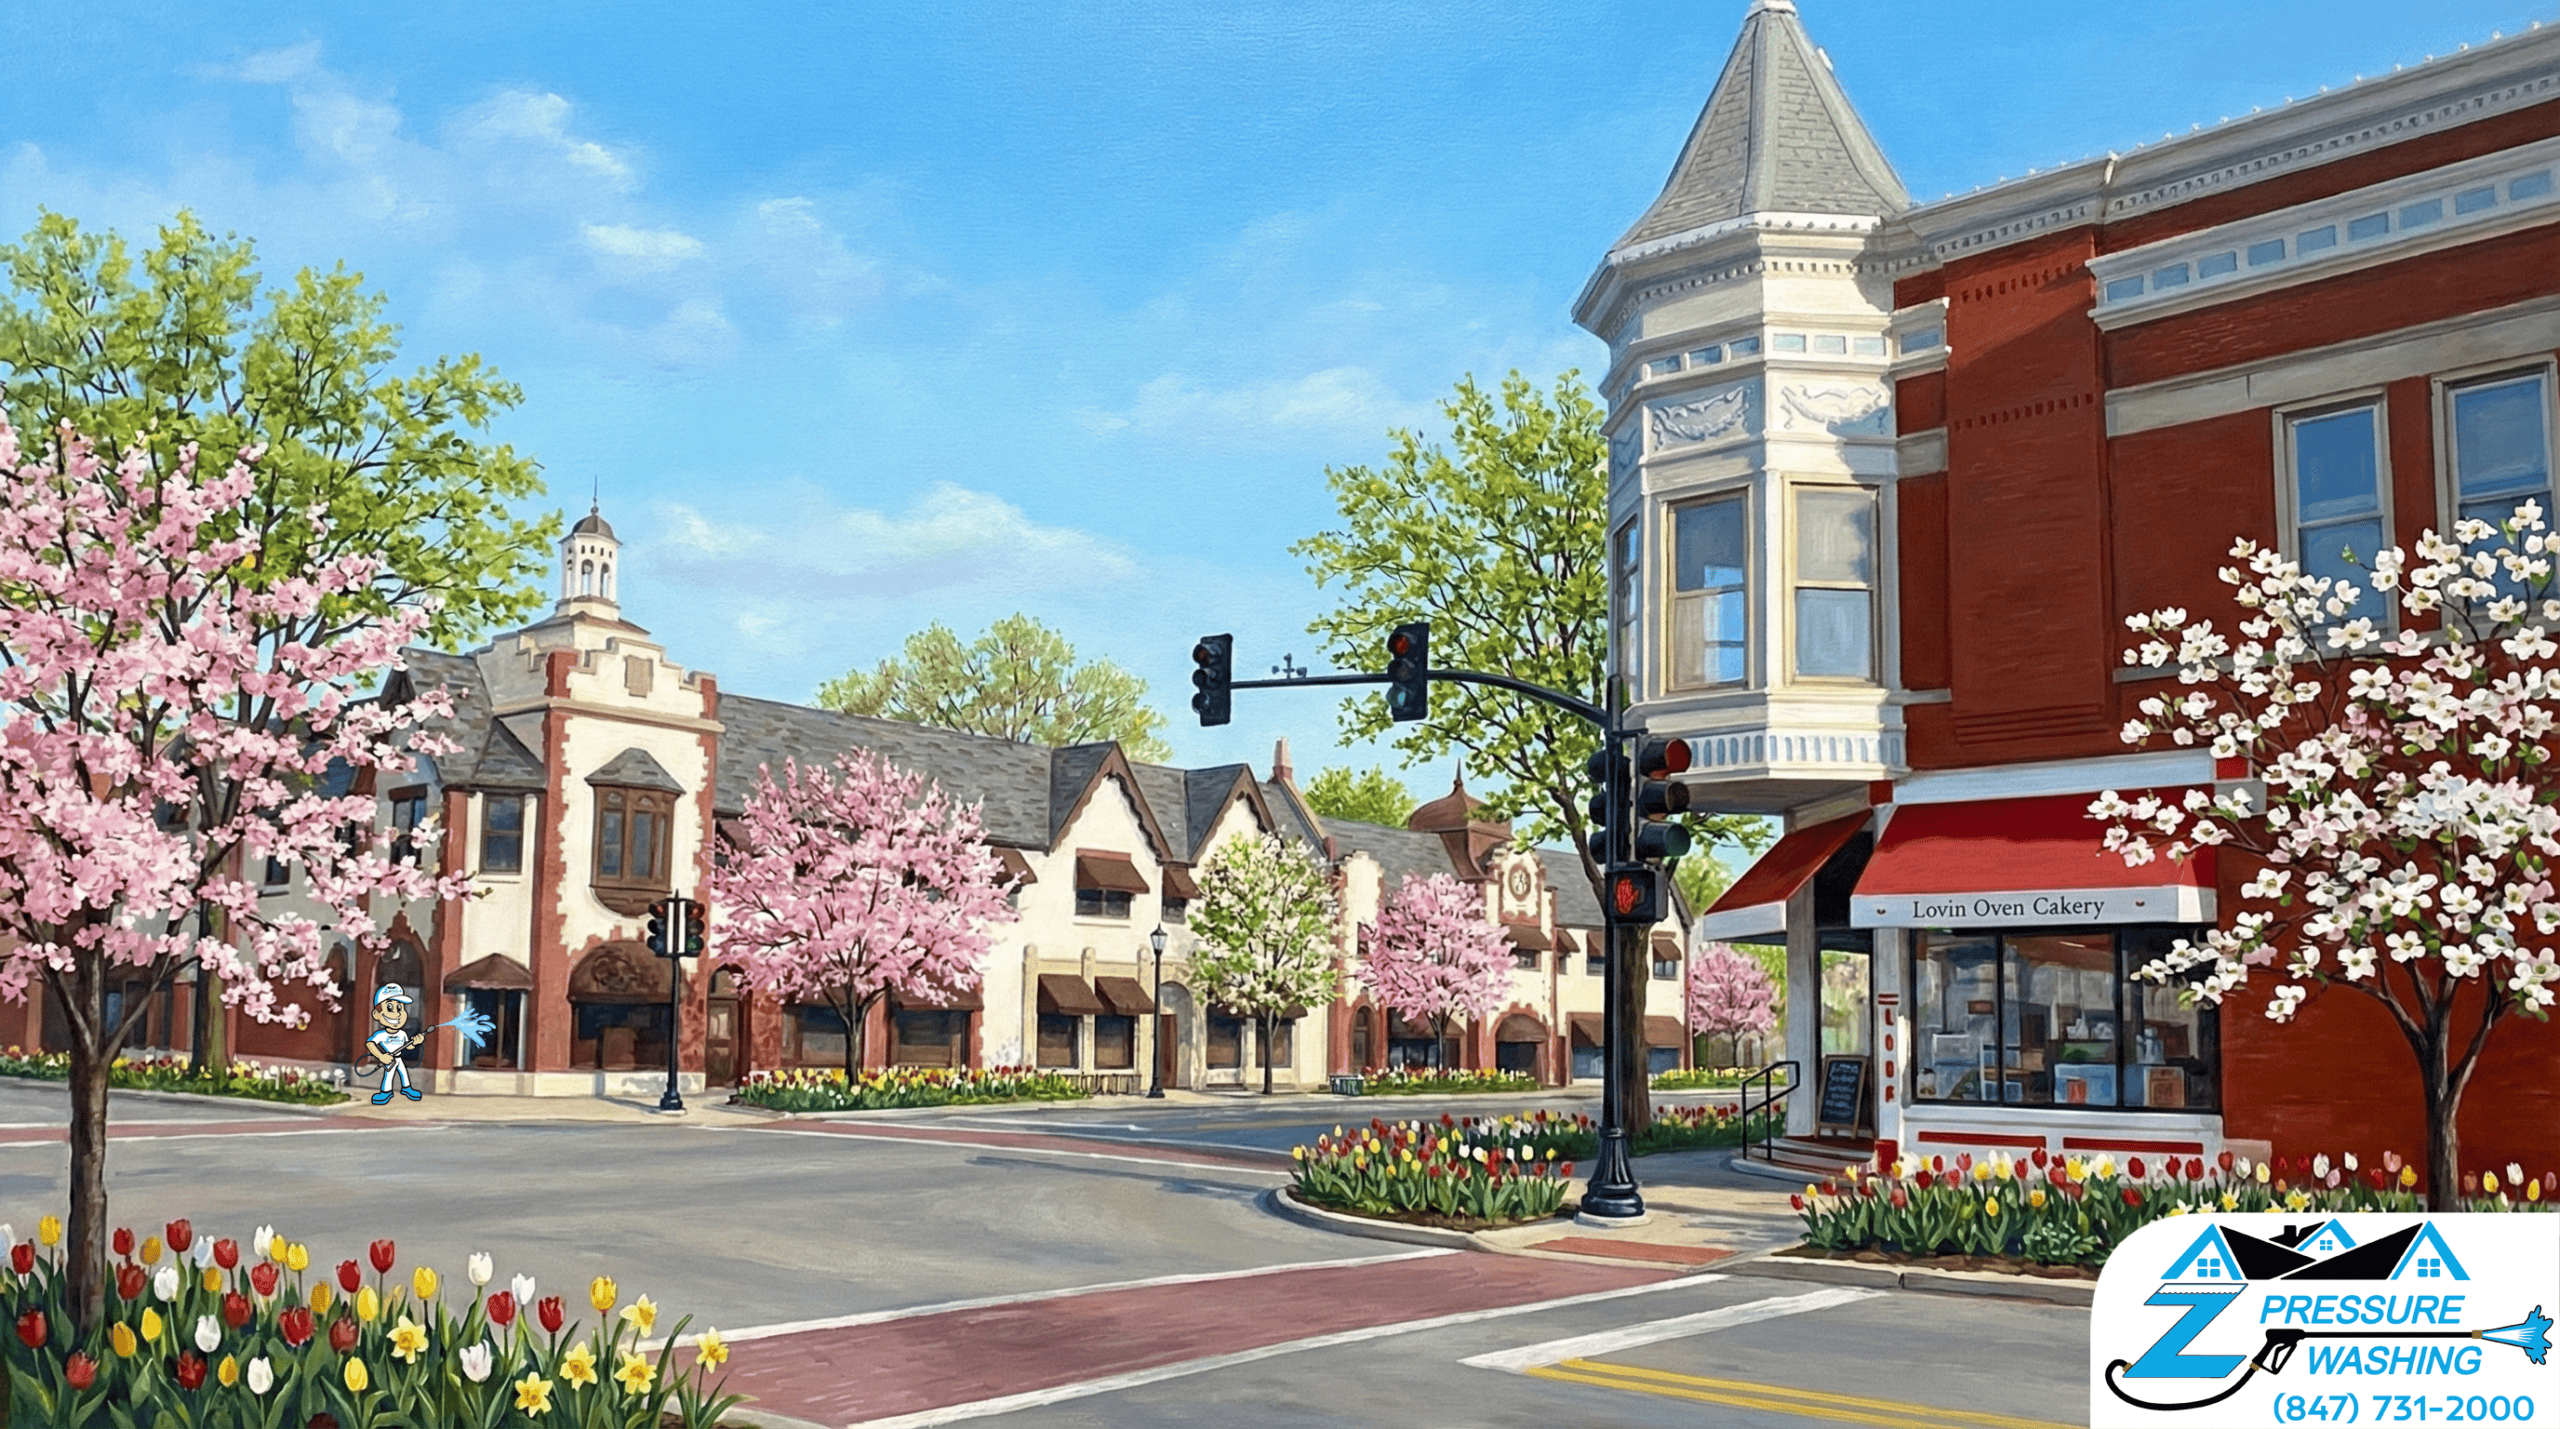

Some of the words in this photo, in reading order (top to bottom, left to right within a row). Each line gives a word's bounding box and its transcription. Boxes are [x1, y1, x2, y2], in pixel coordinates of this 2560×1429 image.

[1912, 899, 1967, 919] Lovin
[1973, 898, 2025, 917] Oven
[2033, 895, 2105, 920] Cakery
